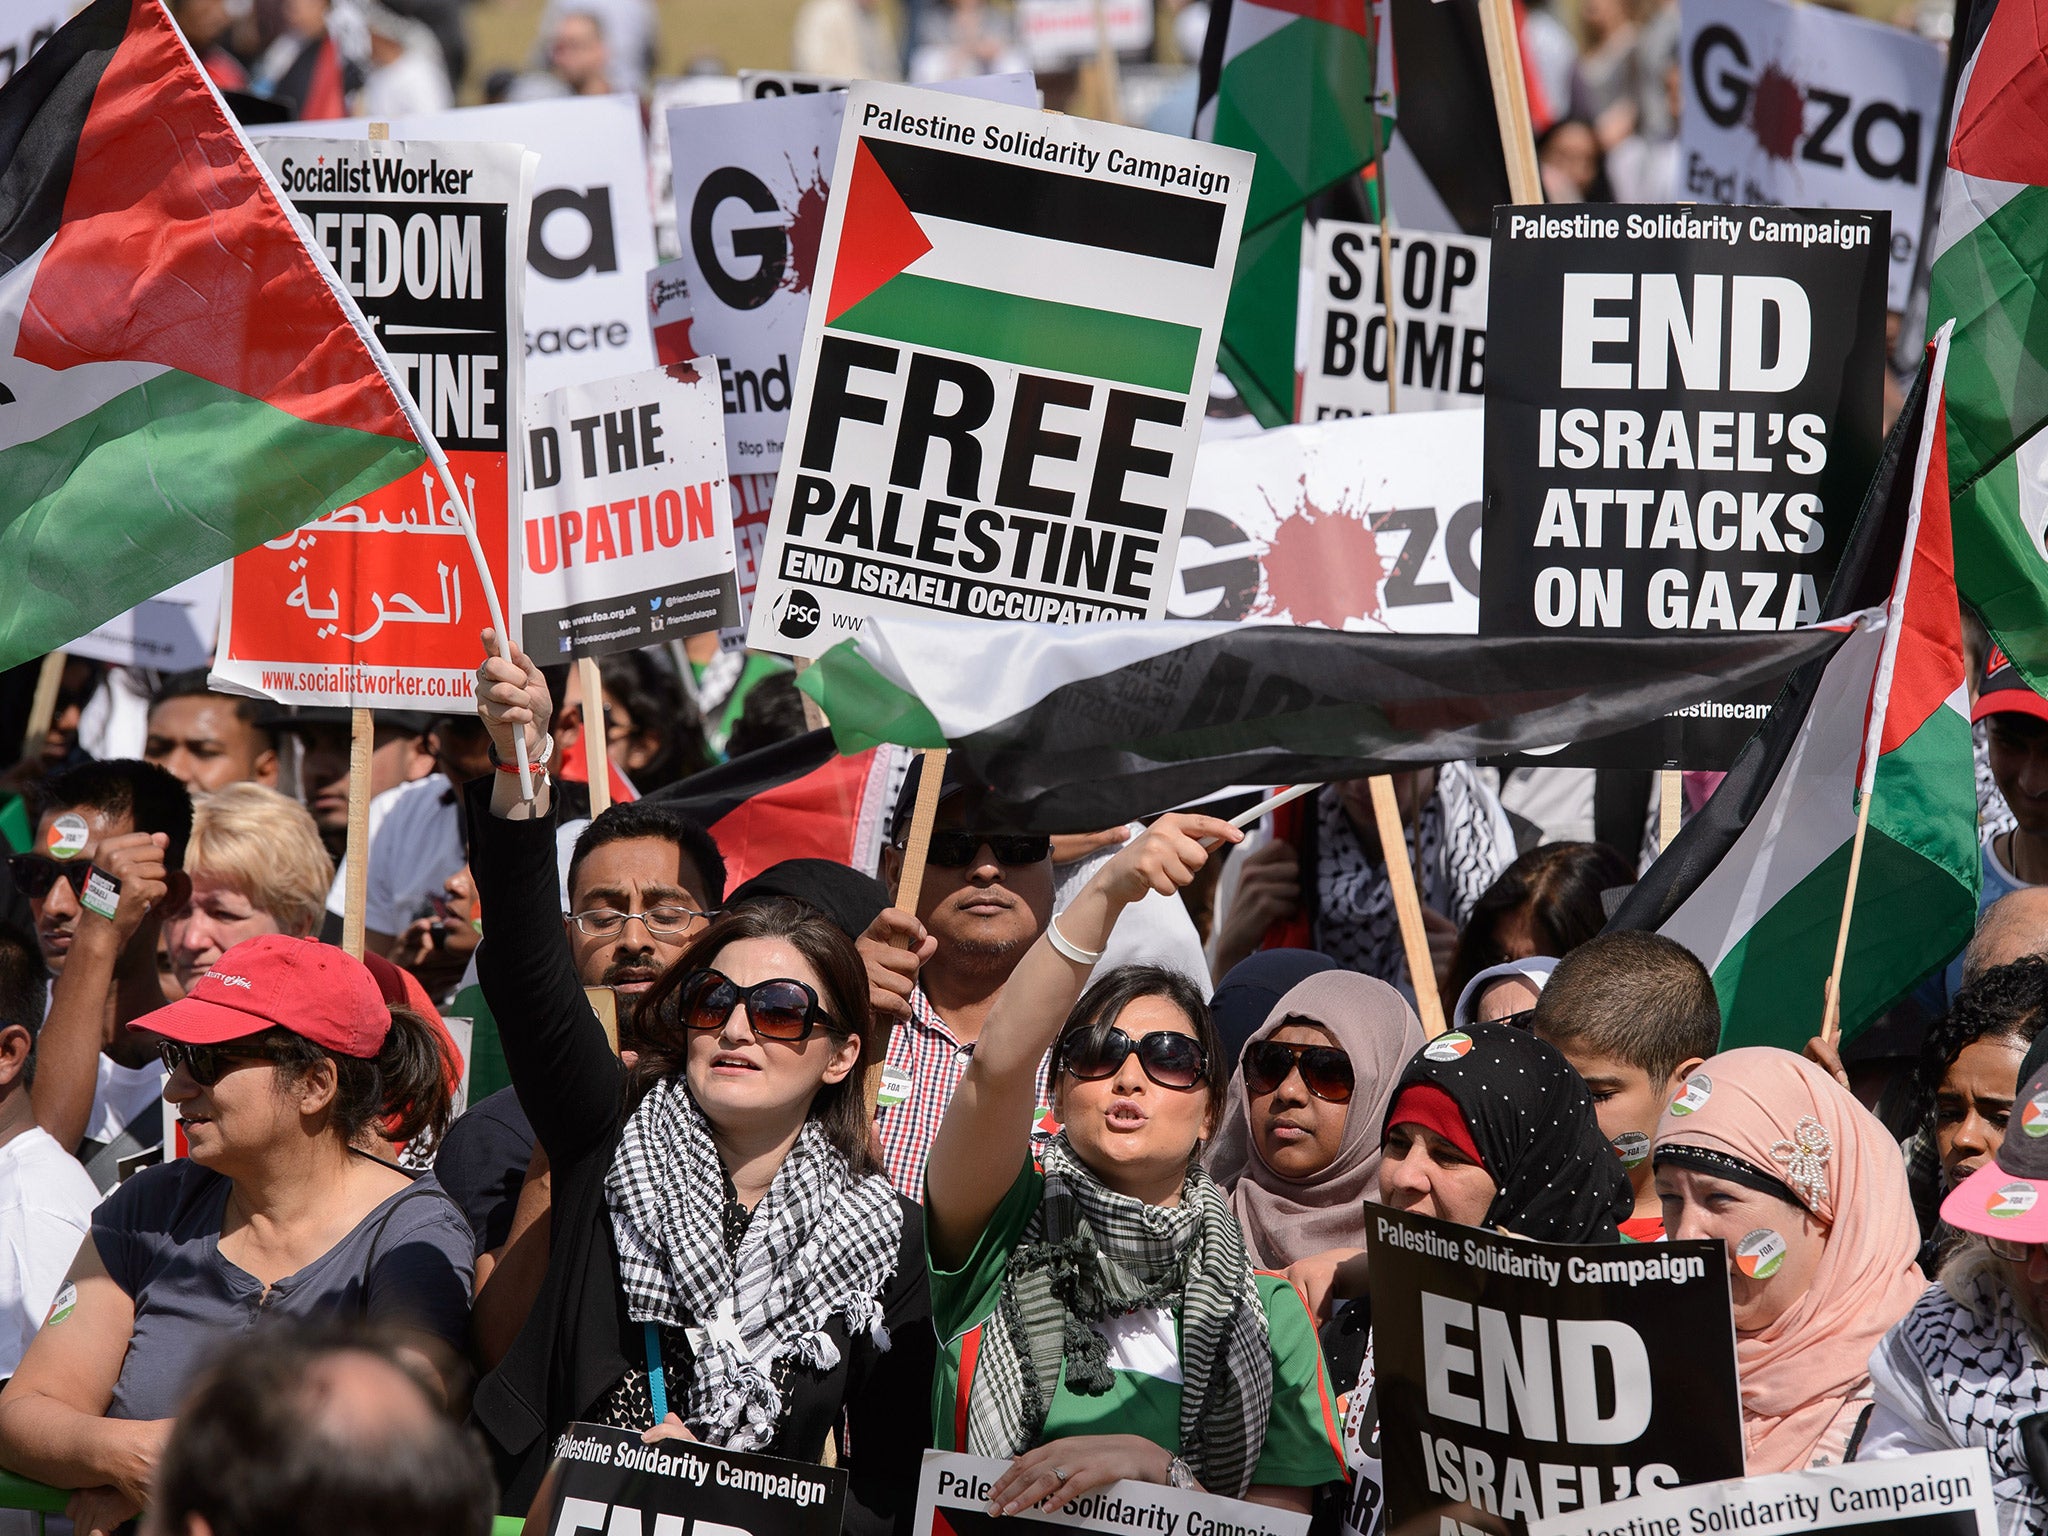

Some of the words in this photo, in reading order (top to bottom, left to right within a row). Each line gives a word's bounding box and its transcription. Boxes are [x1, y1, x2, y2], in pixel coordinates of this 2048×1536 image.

[861, 103, 976, 146] Palestine
[983, 126, 1100, 174] Solidarity
[1107, 149, 1231, 196] Campaign
[298, 213, 483, 300] EEDOM
[1510, 214, 1619, 240] Palestine
[1626, 214, 1743, 246] Solidarity
[1749, 216, 1872, 250] Campaign
[1328, 232, 1477, 314] STOP
[1560, 272, 1812, 393] END
[571, 402, 665, 479] THE
[738, 439, 764, 457] Stop
[799, 334, 1187, 534] FREE
[1538, 408, 1828, 476] ISRAEL'S
[523, 481, 715, 575] UPATION
[785, 473, 1160, 601] PALESTINE
[1532, 488, 1825, 554] ATTACKS
[286, 557, 462, 643] الحرية
[785, 550, 844, 585] END
[851, 561, 961, 611] ISRAELI
[1533, 566, 1624, 629] ON
[1647, 568, 1823, 632] GAZA
[786, 603, 819, 627] PSC
[262, 667, 472, 698] www.socialistworker.co.uk
[1664, 700, 1773, 720] estinecam
[886, 1082, 900, 1092] FOA
[1377, 1217, 1459, 1262] Palestine
[1464, 1239, 1561, 1287] Solidarity
[1568, 1253, 1705, 1286] Campaign
[1759, 1244, 1774, 1257] FOA
[1420, 1291, 1653, 1445] END
[555, 1433, 610, 1465] Palestine
[613, 1441, 709, 1487] Solidarity
[715, 1460, 827, 1507] Campaign
[1063, 1493, 1179, 1536] Solidarity
[1689, 1492, 1820, 1536] Solidarity
[1831, 1474, 1973, 1513] Campaign
